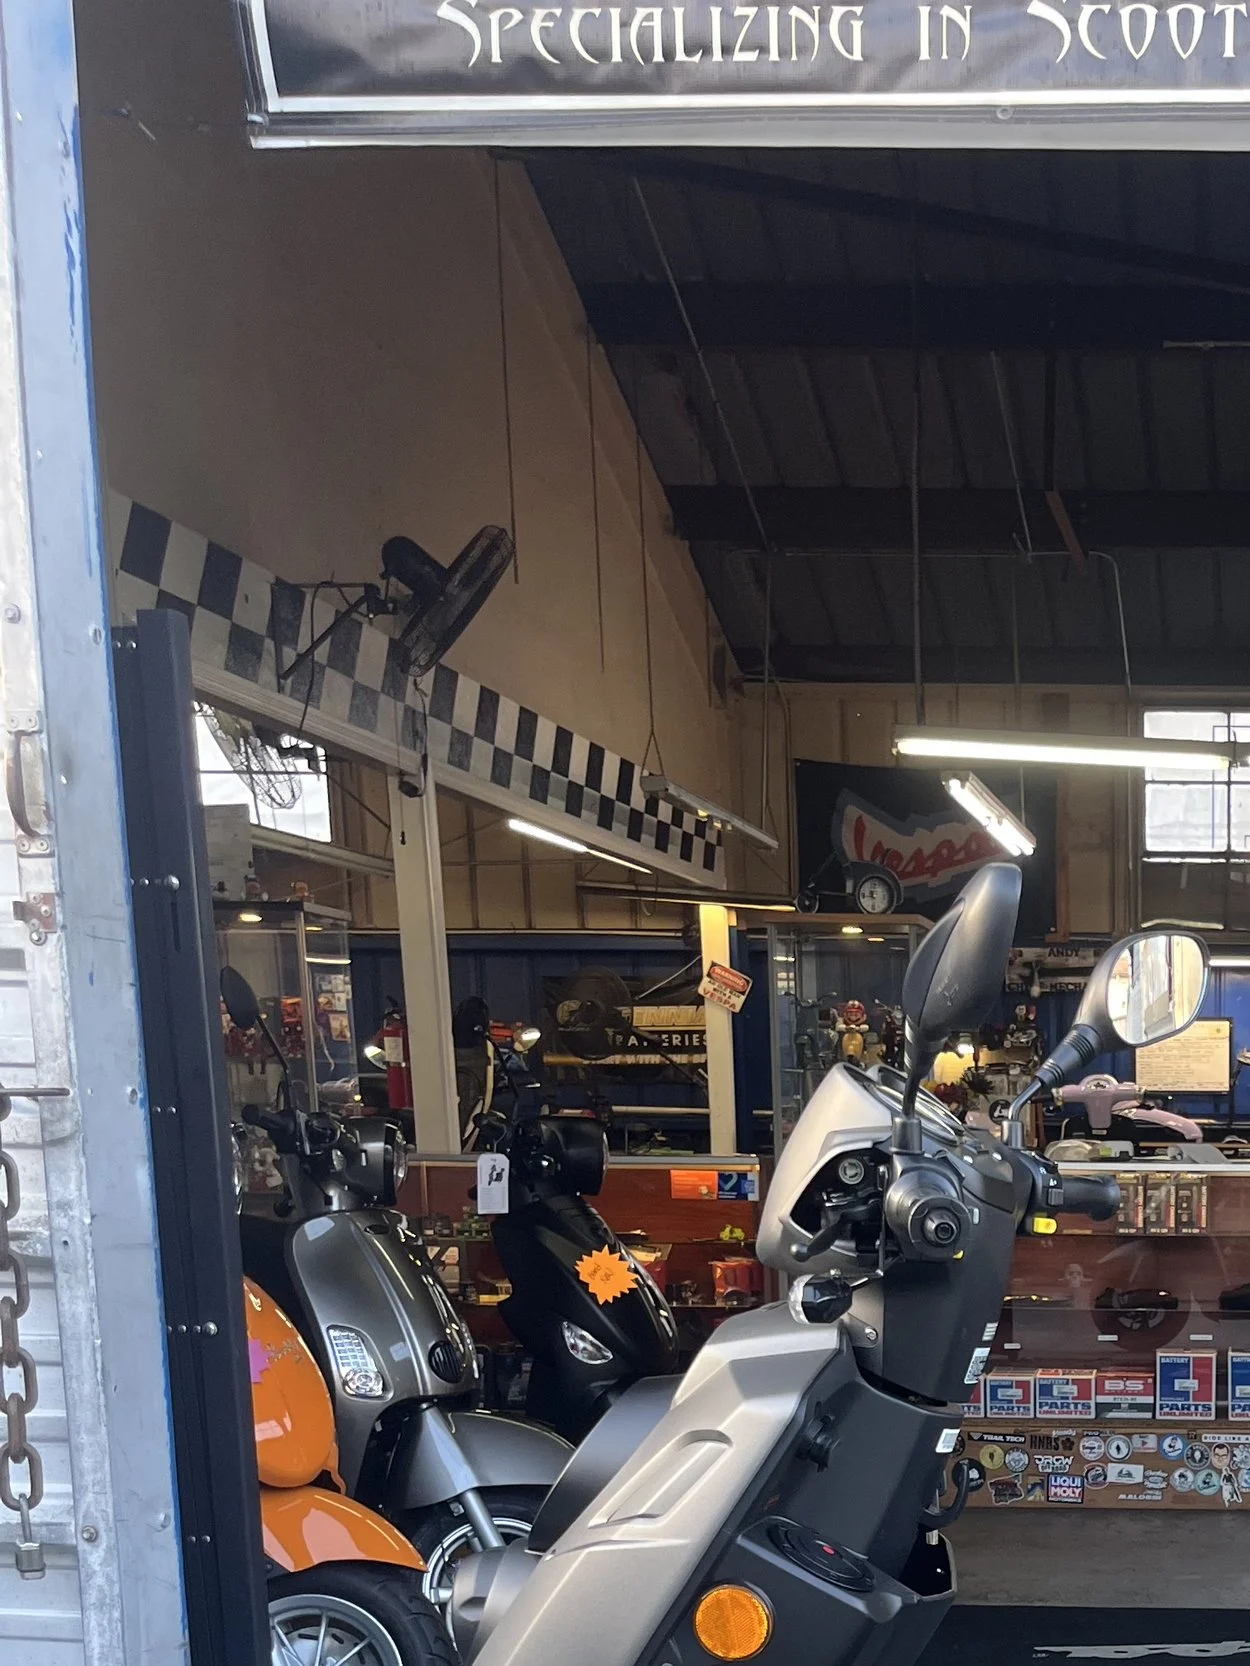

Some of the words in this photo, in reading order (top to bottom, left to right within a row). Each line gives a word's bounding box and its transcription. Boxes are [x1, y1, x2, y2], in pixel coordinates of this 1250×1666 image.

[436, 0, 865, 67] SPECIALIZING
[917, 4, 972, 62] IN
[1047, 946, 1081, 958] ANDY
[1049, 981, 1089, 992] MECHA
[702, 987, 737, 1010] VESPA
[1104, 1379, 1145, 1391] BS
[1038, 1401, 1092, 1410] PARTS
[1159, 1403, 1212, 1412] PARTS
[982, 1434, 1005, 1442] TRAIL
[1006, 1435, 1026, 1443] TECH
[1051, 1475, 1082, 1487] LIQUI
[1050, 1487, 1083, 1498] MOLY
